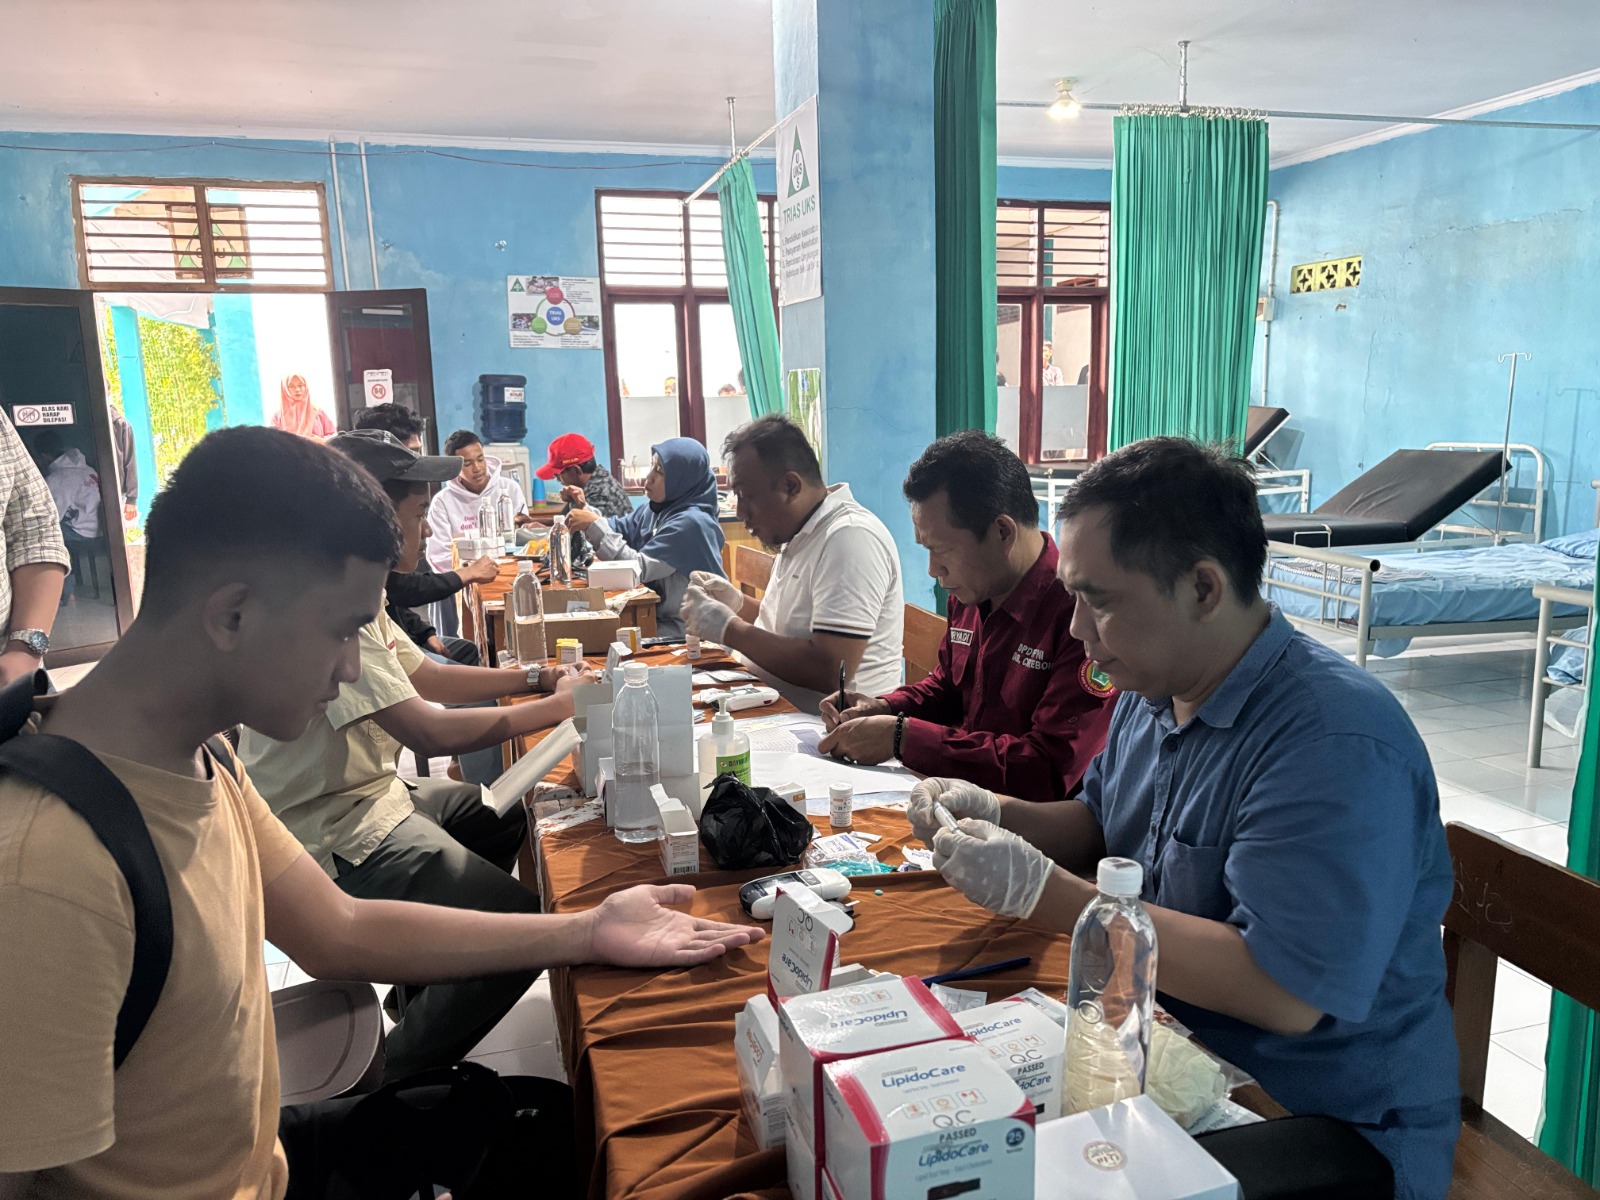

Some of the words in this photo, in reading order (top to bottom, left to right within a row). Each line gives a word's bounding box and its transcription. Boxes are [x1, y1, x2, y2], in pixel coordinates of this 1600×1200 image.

[783, 202, 801, 225] TRIAS
[802, 194, 816, 215] UKS
[951, 631, 970, 643] RYADI
[782, 953, 813, 990] LipidoCare
[830, 1010, 908, 1029] LipidoCare
[965, 1018, 1022, 1037] ipidoCare
[881, 1064, 966, 1088] LipidoCare
[1017, 1062, 1045, 1075] PASSED
[1019, 1075, 1051, 1091] doCare
[939, 1128, 977, 1142] PASSED
[1007, 1131, 1023, 1144] 25
[918, 1143, 990, 1167] LipidoCare
